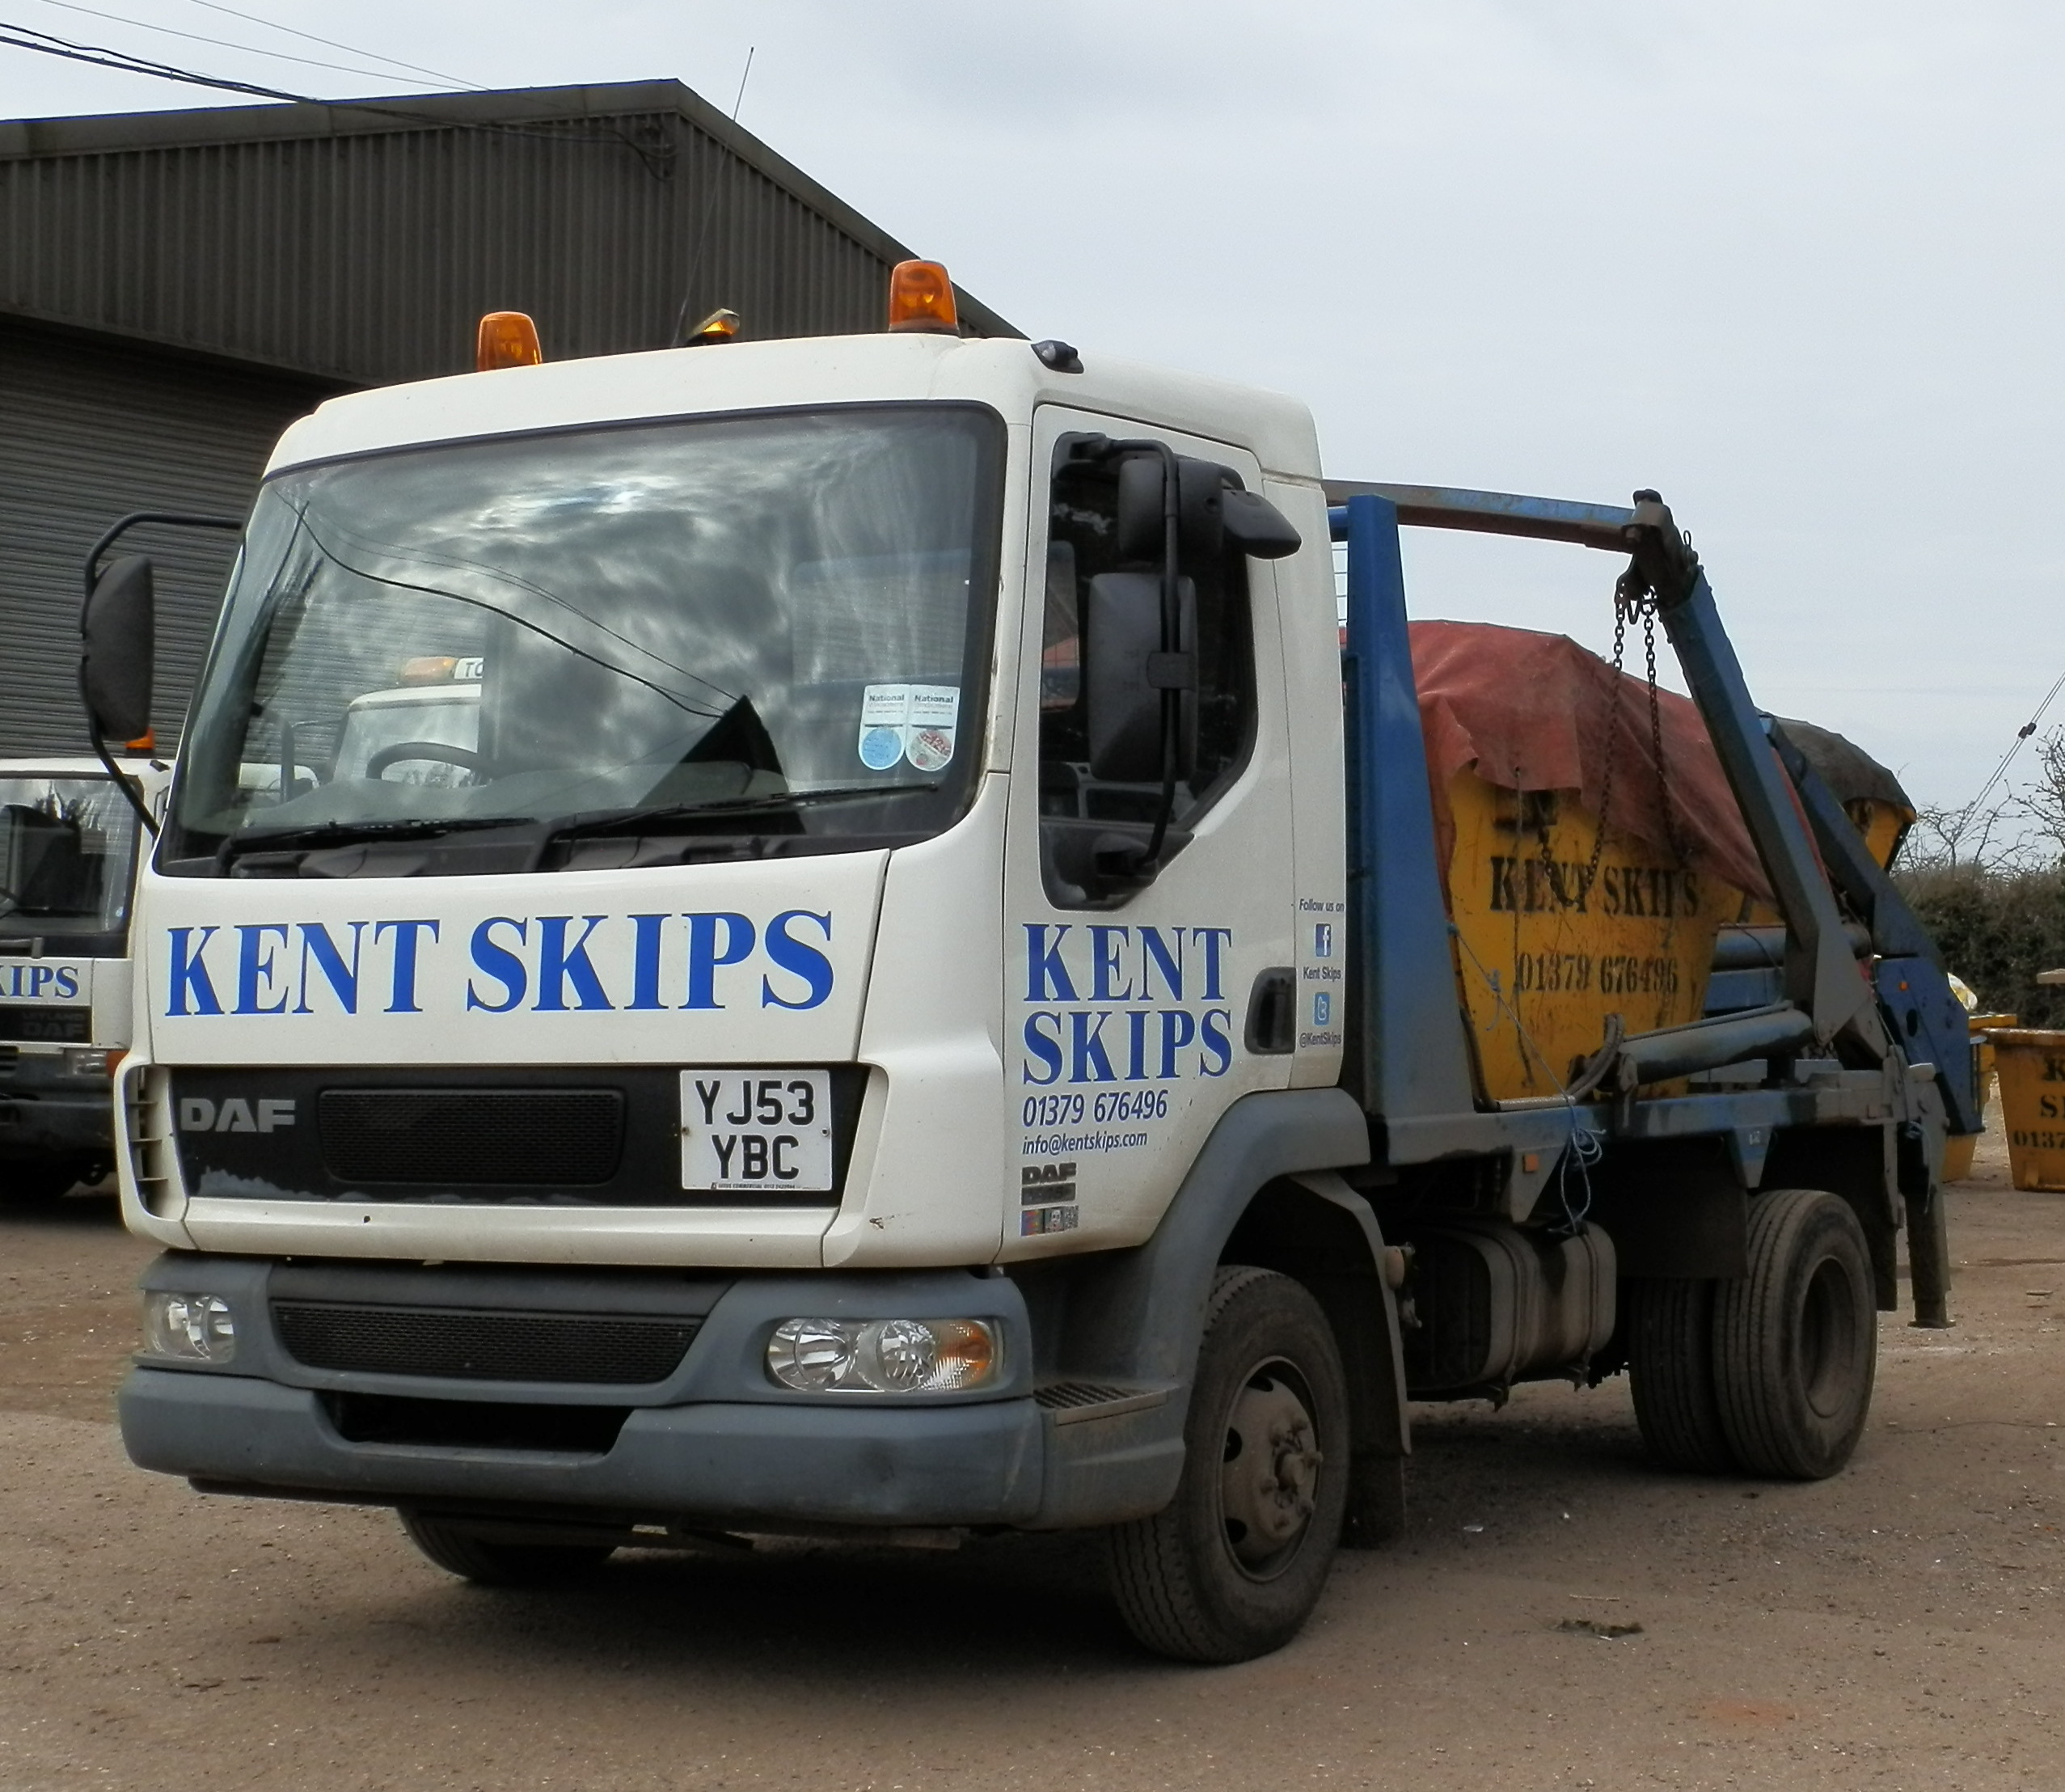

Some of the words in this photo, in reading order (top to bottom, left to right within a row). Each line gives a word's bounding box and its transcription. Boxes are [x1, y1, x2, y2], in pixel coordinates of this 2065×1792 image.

[914, 695, 954, 703] National
[1299, 899, 1324, 911] Follow
[1326, 902, 1334, 911] us
[1336, 902, 1345, 912] on
[167, 920, 440, 1016] KENT
[467, 911, 834, 1012] SKIPS
[1022, 923, 1232, 1002] KENT
[1303, 967, 1320, 979] Kent
[1322, 967, 1341, 981] Skips
[1518, 952, 1590, 991] 01379
[0, 965, 78, 999] IPS
[1023, 1009, 1233, 1085] SKIPS
[1299, 1033, 1341, 1047] @KentSkips
[181, 1097, 295, 1132] DAF
[695, 1080, 815, 1125] YJ53
[1023, 1095, 1084, 1126] 01379
[1093, 1089, 1168, 1123] 676496
[2041, 1095, 2065, 1118] S
[712, 1135, 799, 1179] YBC
[1022, 1131, 1147, 1156] info@kentskips.com
[1022, 1163, 1076, 1184] DAF
